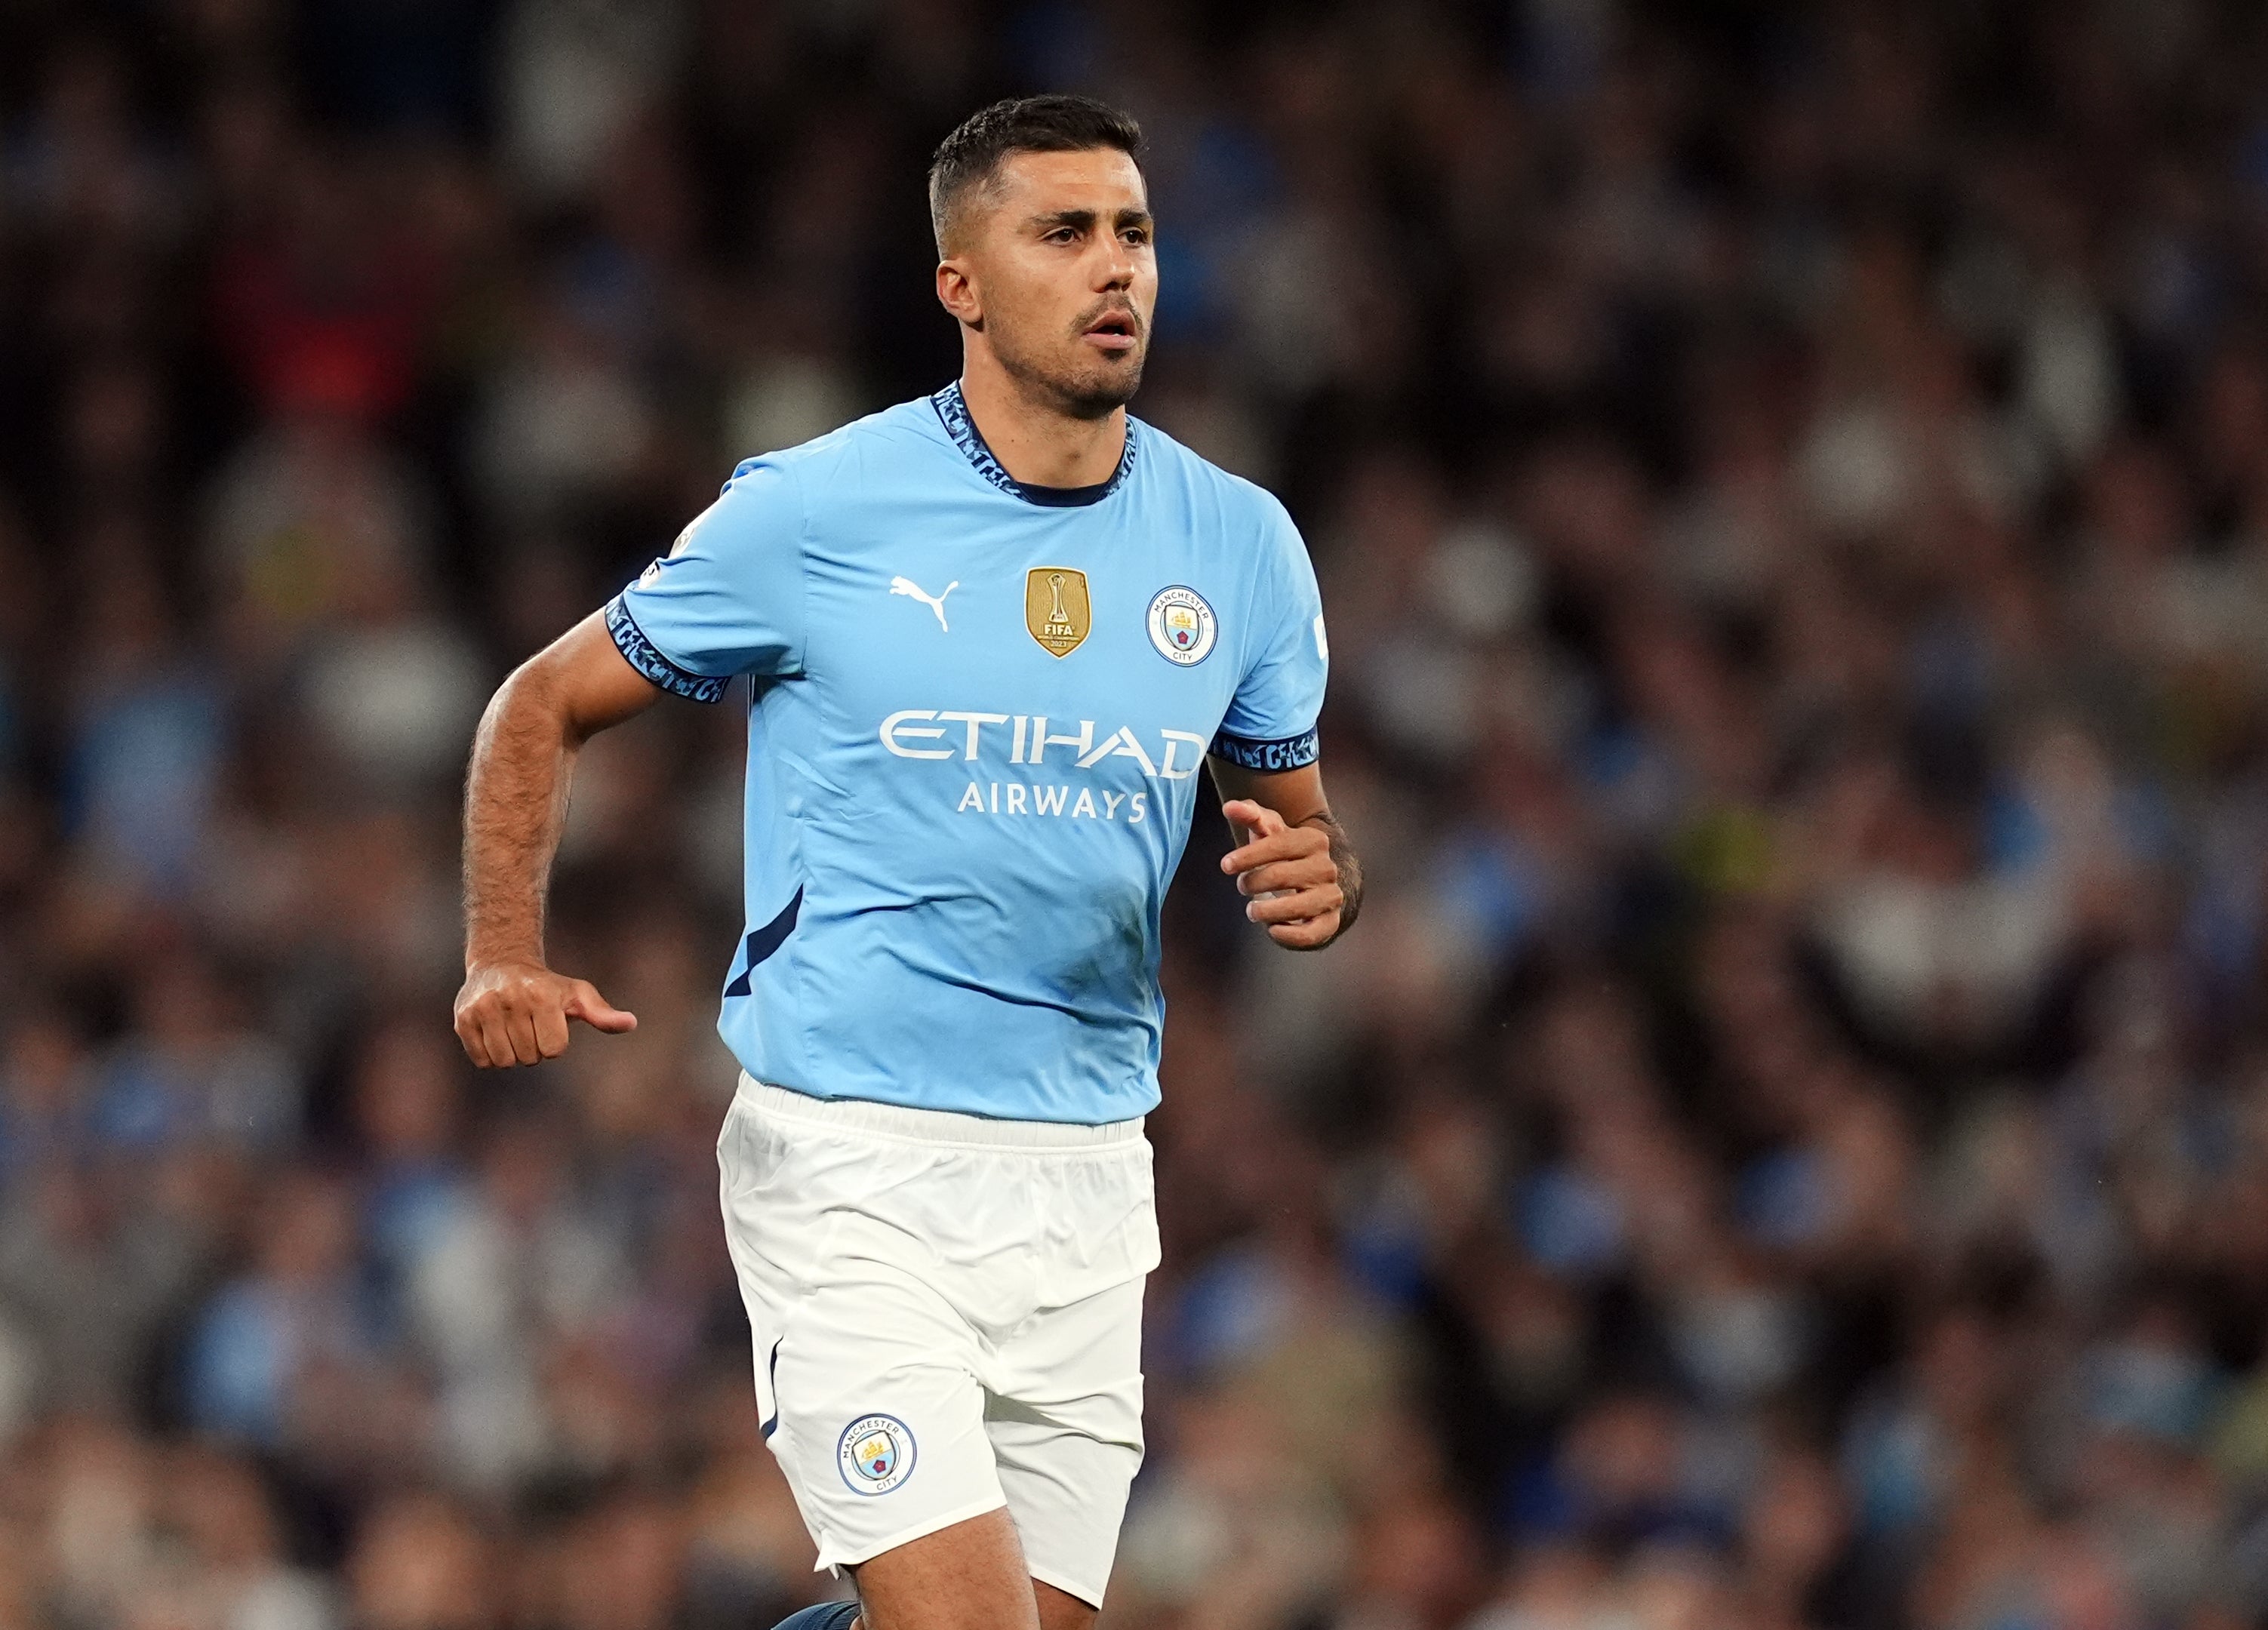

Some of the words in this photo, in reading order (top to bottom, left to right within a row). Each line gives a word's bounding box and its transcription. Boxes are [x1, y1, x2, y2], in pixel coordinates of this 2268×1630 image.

[1154, 592, 1209, 620] MANCHESTER
[1044, 624, 1073, 636] FIFA
[1173, 652, 1192, 661] CITY
[879, 709, 1207, 780] ETIHAD
[957, 782, 1147, 823] AIRWAYS
[843, 1419, 900, 1459] MANCHESTER
[876, 1475, 897, 1490] CITY
